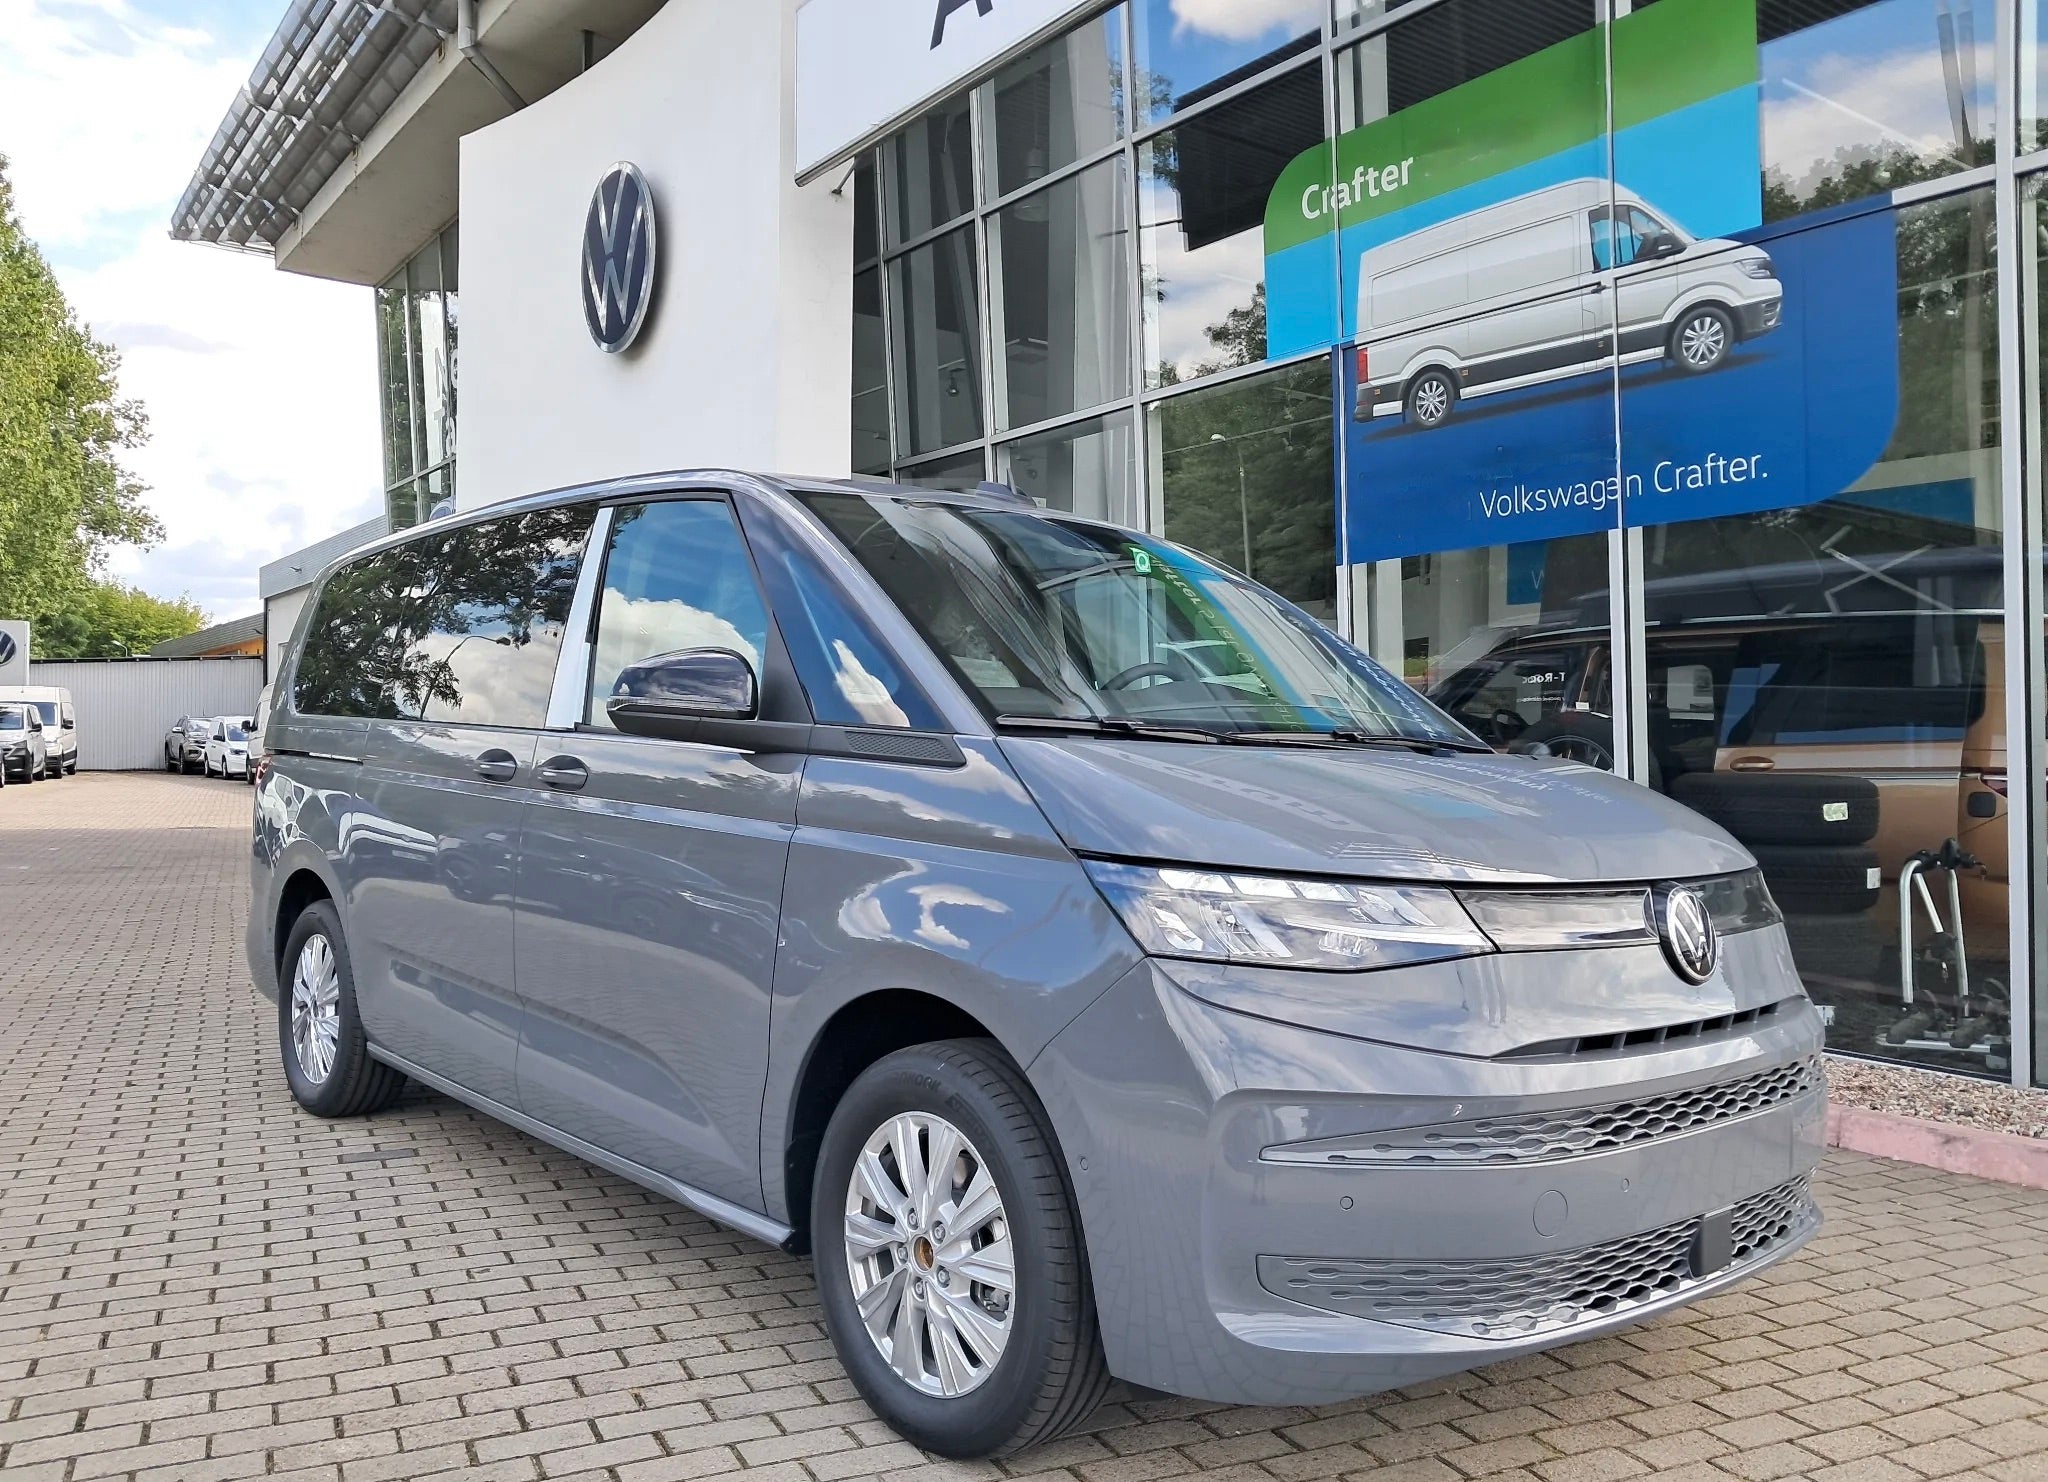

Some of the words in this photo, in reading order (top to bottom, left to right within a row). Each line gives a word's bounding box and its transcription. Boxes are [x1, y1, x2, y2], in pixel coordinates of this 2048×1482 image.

[1302, 157, 1414, 219] Crafter
[1480, 474, 1642, 518] Volkswagen
[1654, 453, 1768, 493] Crafter.
